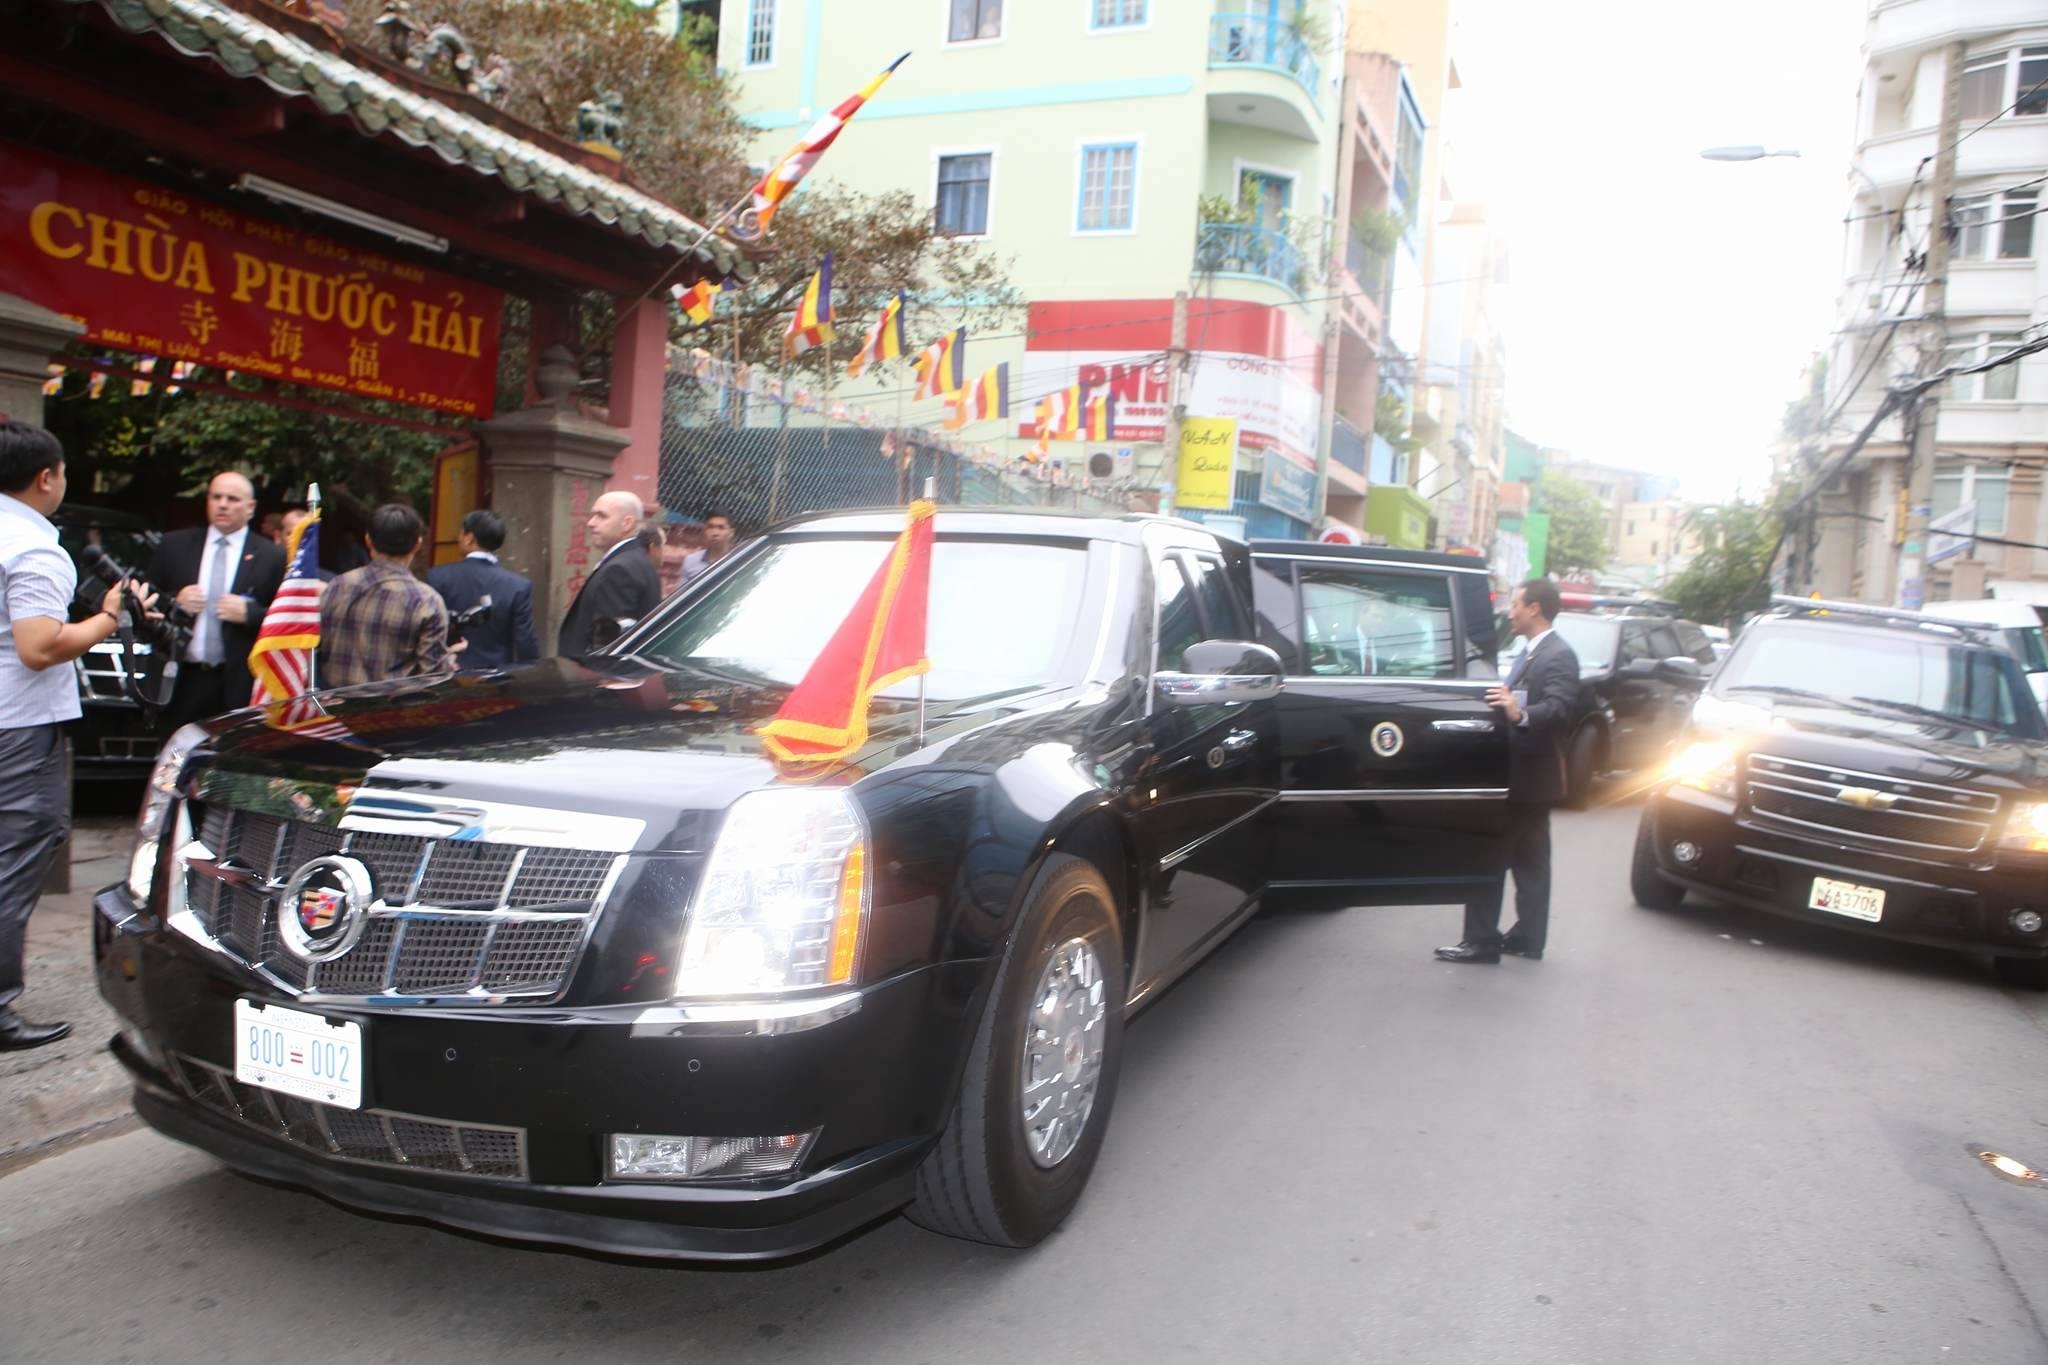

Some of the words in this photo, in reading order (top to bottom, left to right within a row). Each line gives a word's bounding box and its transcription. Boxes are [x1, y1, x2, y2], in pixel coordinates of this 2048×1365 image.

[29, 201, 215, 294] CHÙA
[231, 251, 397, 336] PHƯỚC
[408, 290, 484, 358] HẢI
[249, 1025, 285, 1068] 800
[311, 1039, 350, 1083] 002
